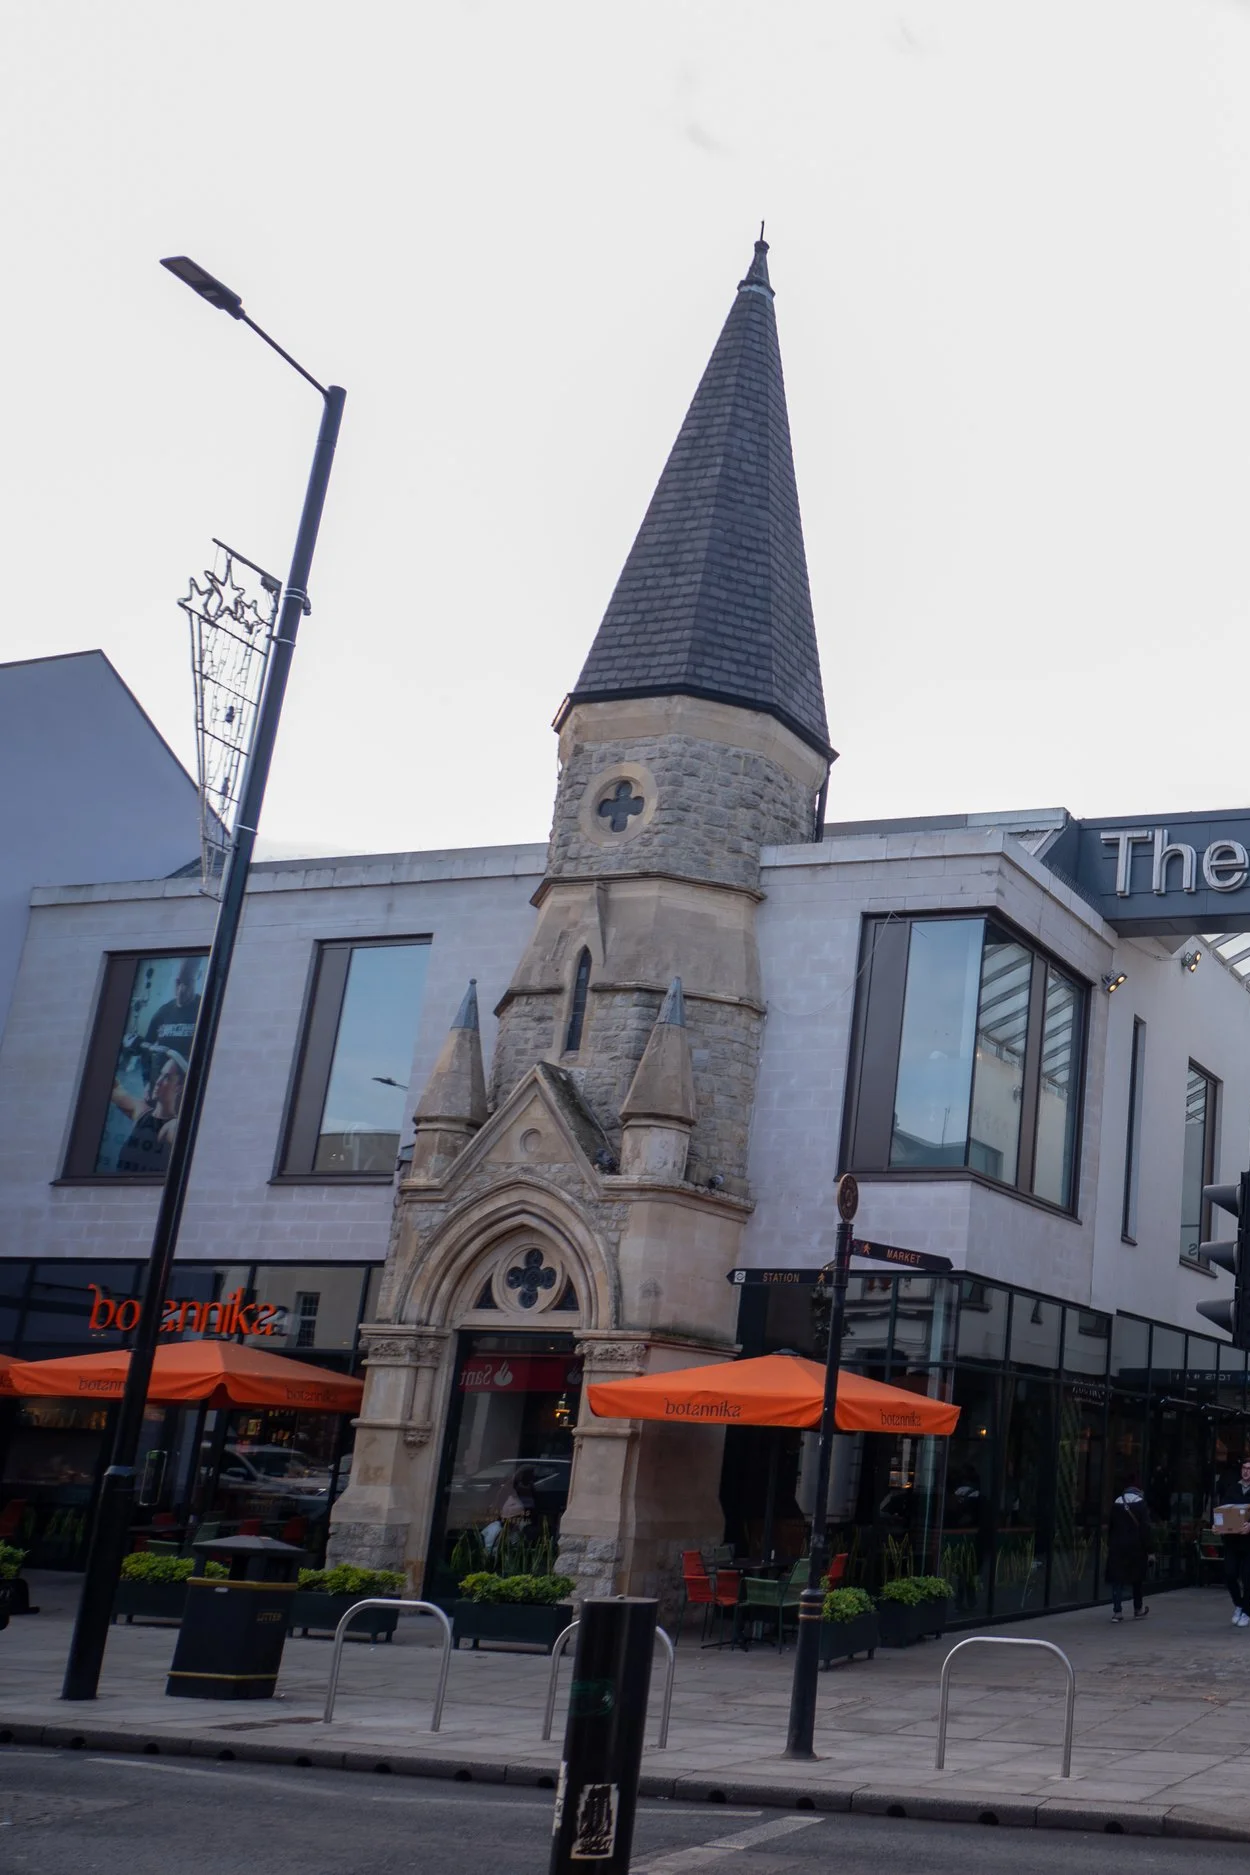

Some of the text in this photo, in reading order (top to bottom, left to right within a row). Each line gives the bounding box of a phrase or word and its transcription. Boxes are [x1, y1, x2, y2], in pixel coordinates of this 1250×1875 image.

[1100, 828, 1250, 898] The
[886, 1249, 921, 1264] MARKET
[763, 1272, 800, 1283] STATION
[88, 1283, 277, 1336] boannika
[79, 1375, 125, 1391] botann
[664, 1398, 741, 1418] botannika
[880, 1408, 921, 1427] botannika
